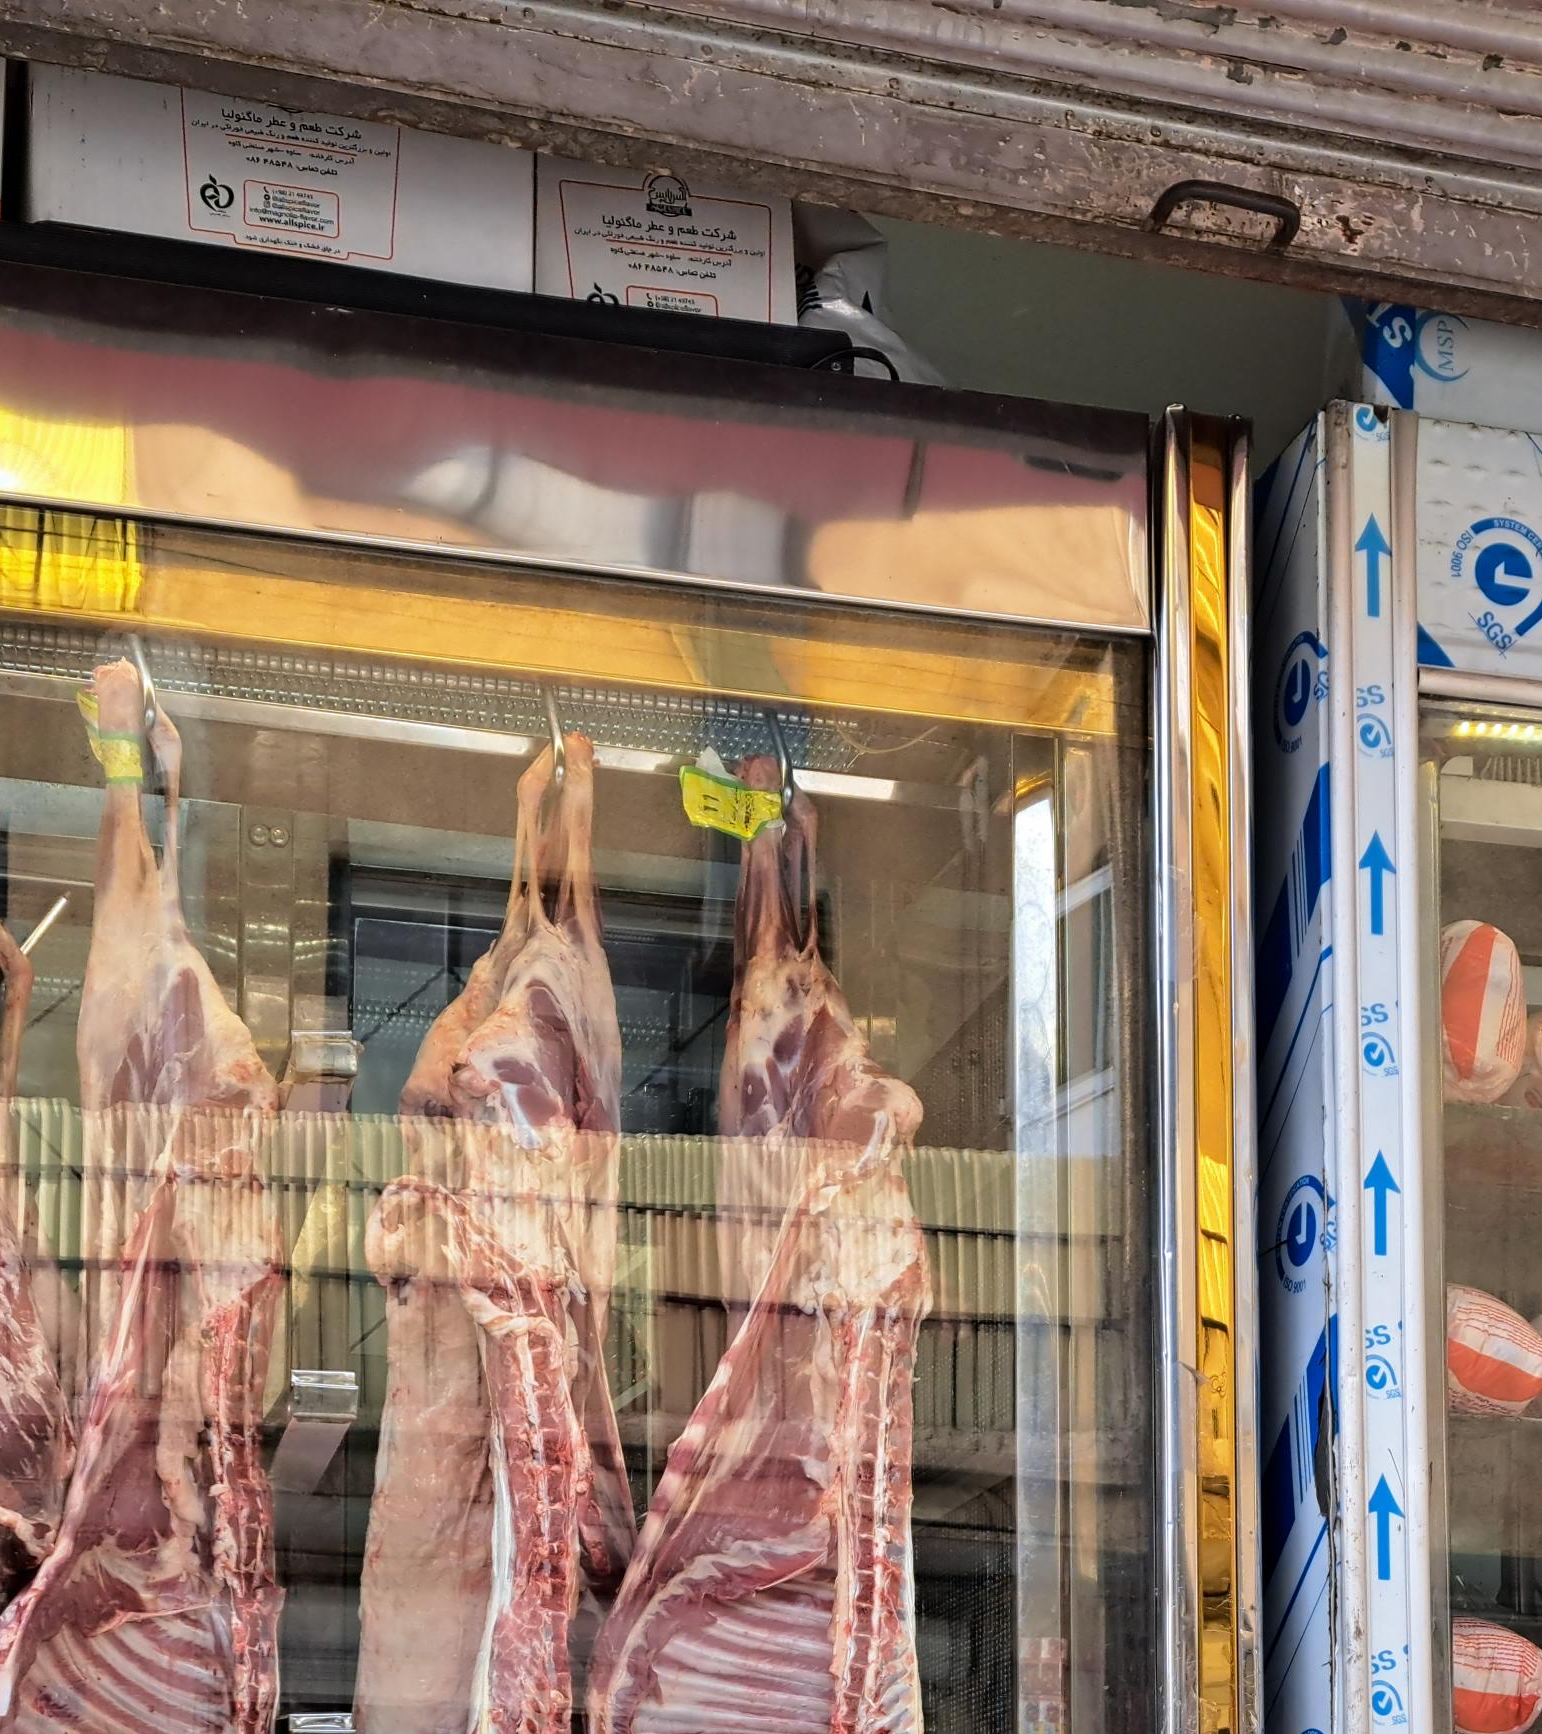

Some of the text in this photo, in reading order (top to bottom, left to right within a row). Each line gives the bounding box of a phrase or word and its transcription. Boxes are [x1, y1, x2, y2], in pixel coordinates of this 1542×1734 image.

[1438, 319, 1457, 372] MSP
[1494, 519, 1527, 535] SYSTEM
[1451, 530, 1473, 577] ISO 9001
[1477, 611, 1512, 650] SGS
